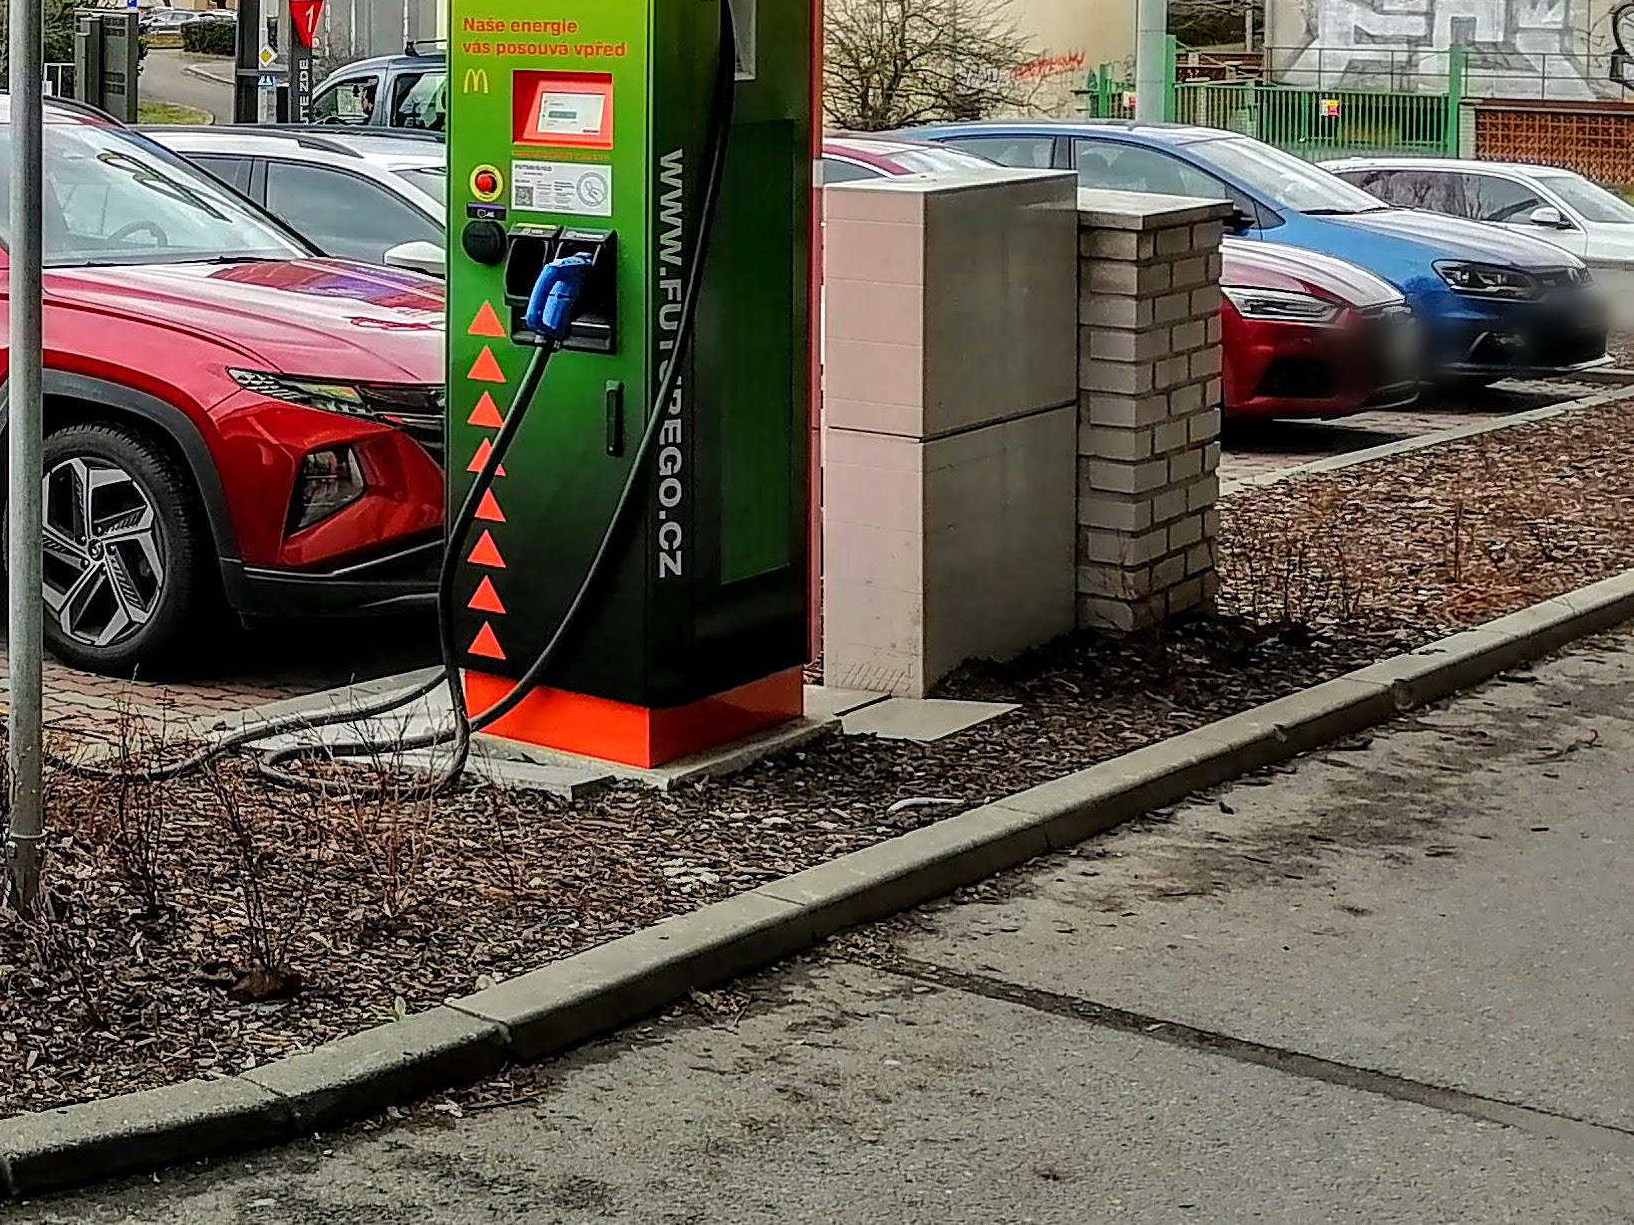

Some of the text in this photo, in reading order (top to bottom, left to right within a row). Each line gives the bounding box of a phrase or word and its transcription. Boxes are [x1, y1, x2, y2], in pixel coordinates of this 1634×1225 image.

[463, 17, 578, 36] Naše energie
[462, 39, 491, 54] vás
[574, 41, 625, 59] vpřed
[299, 58, 309, 92] ZDE
